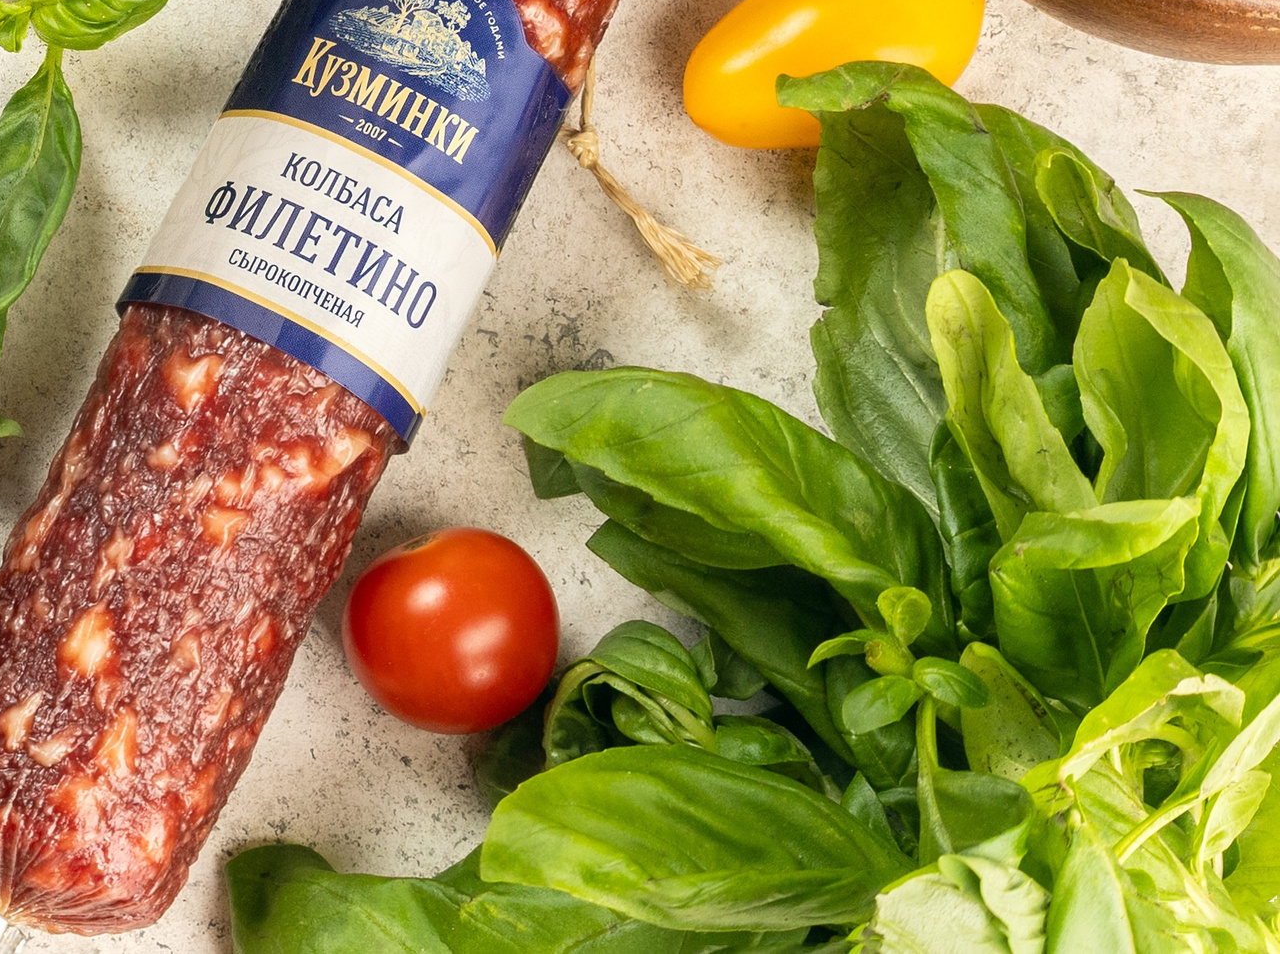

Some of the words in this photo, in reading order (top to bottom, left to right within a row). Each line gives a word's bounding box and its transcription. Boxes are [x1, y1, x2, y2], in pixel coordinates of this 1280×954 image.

[484, 10, 505, 59] ГОДАМИ
[355, 118, 388, 142] 2007
[280, 152, 405, 235] КОЛБАСА
[204, 180, 439, 330] ФИЛЕТИНО
[228, 248, 366, 328] СЫРОКОПЧЕНАЯ
